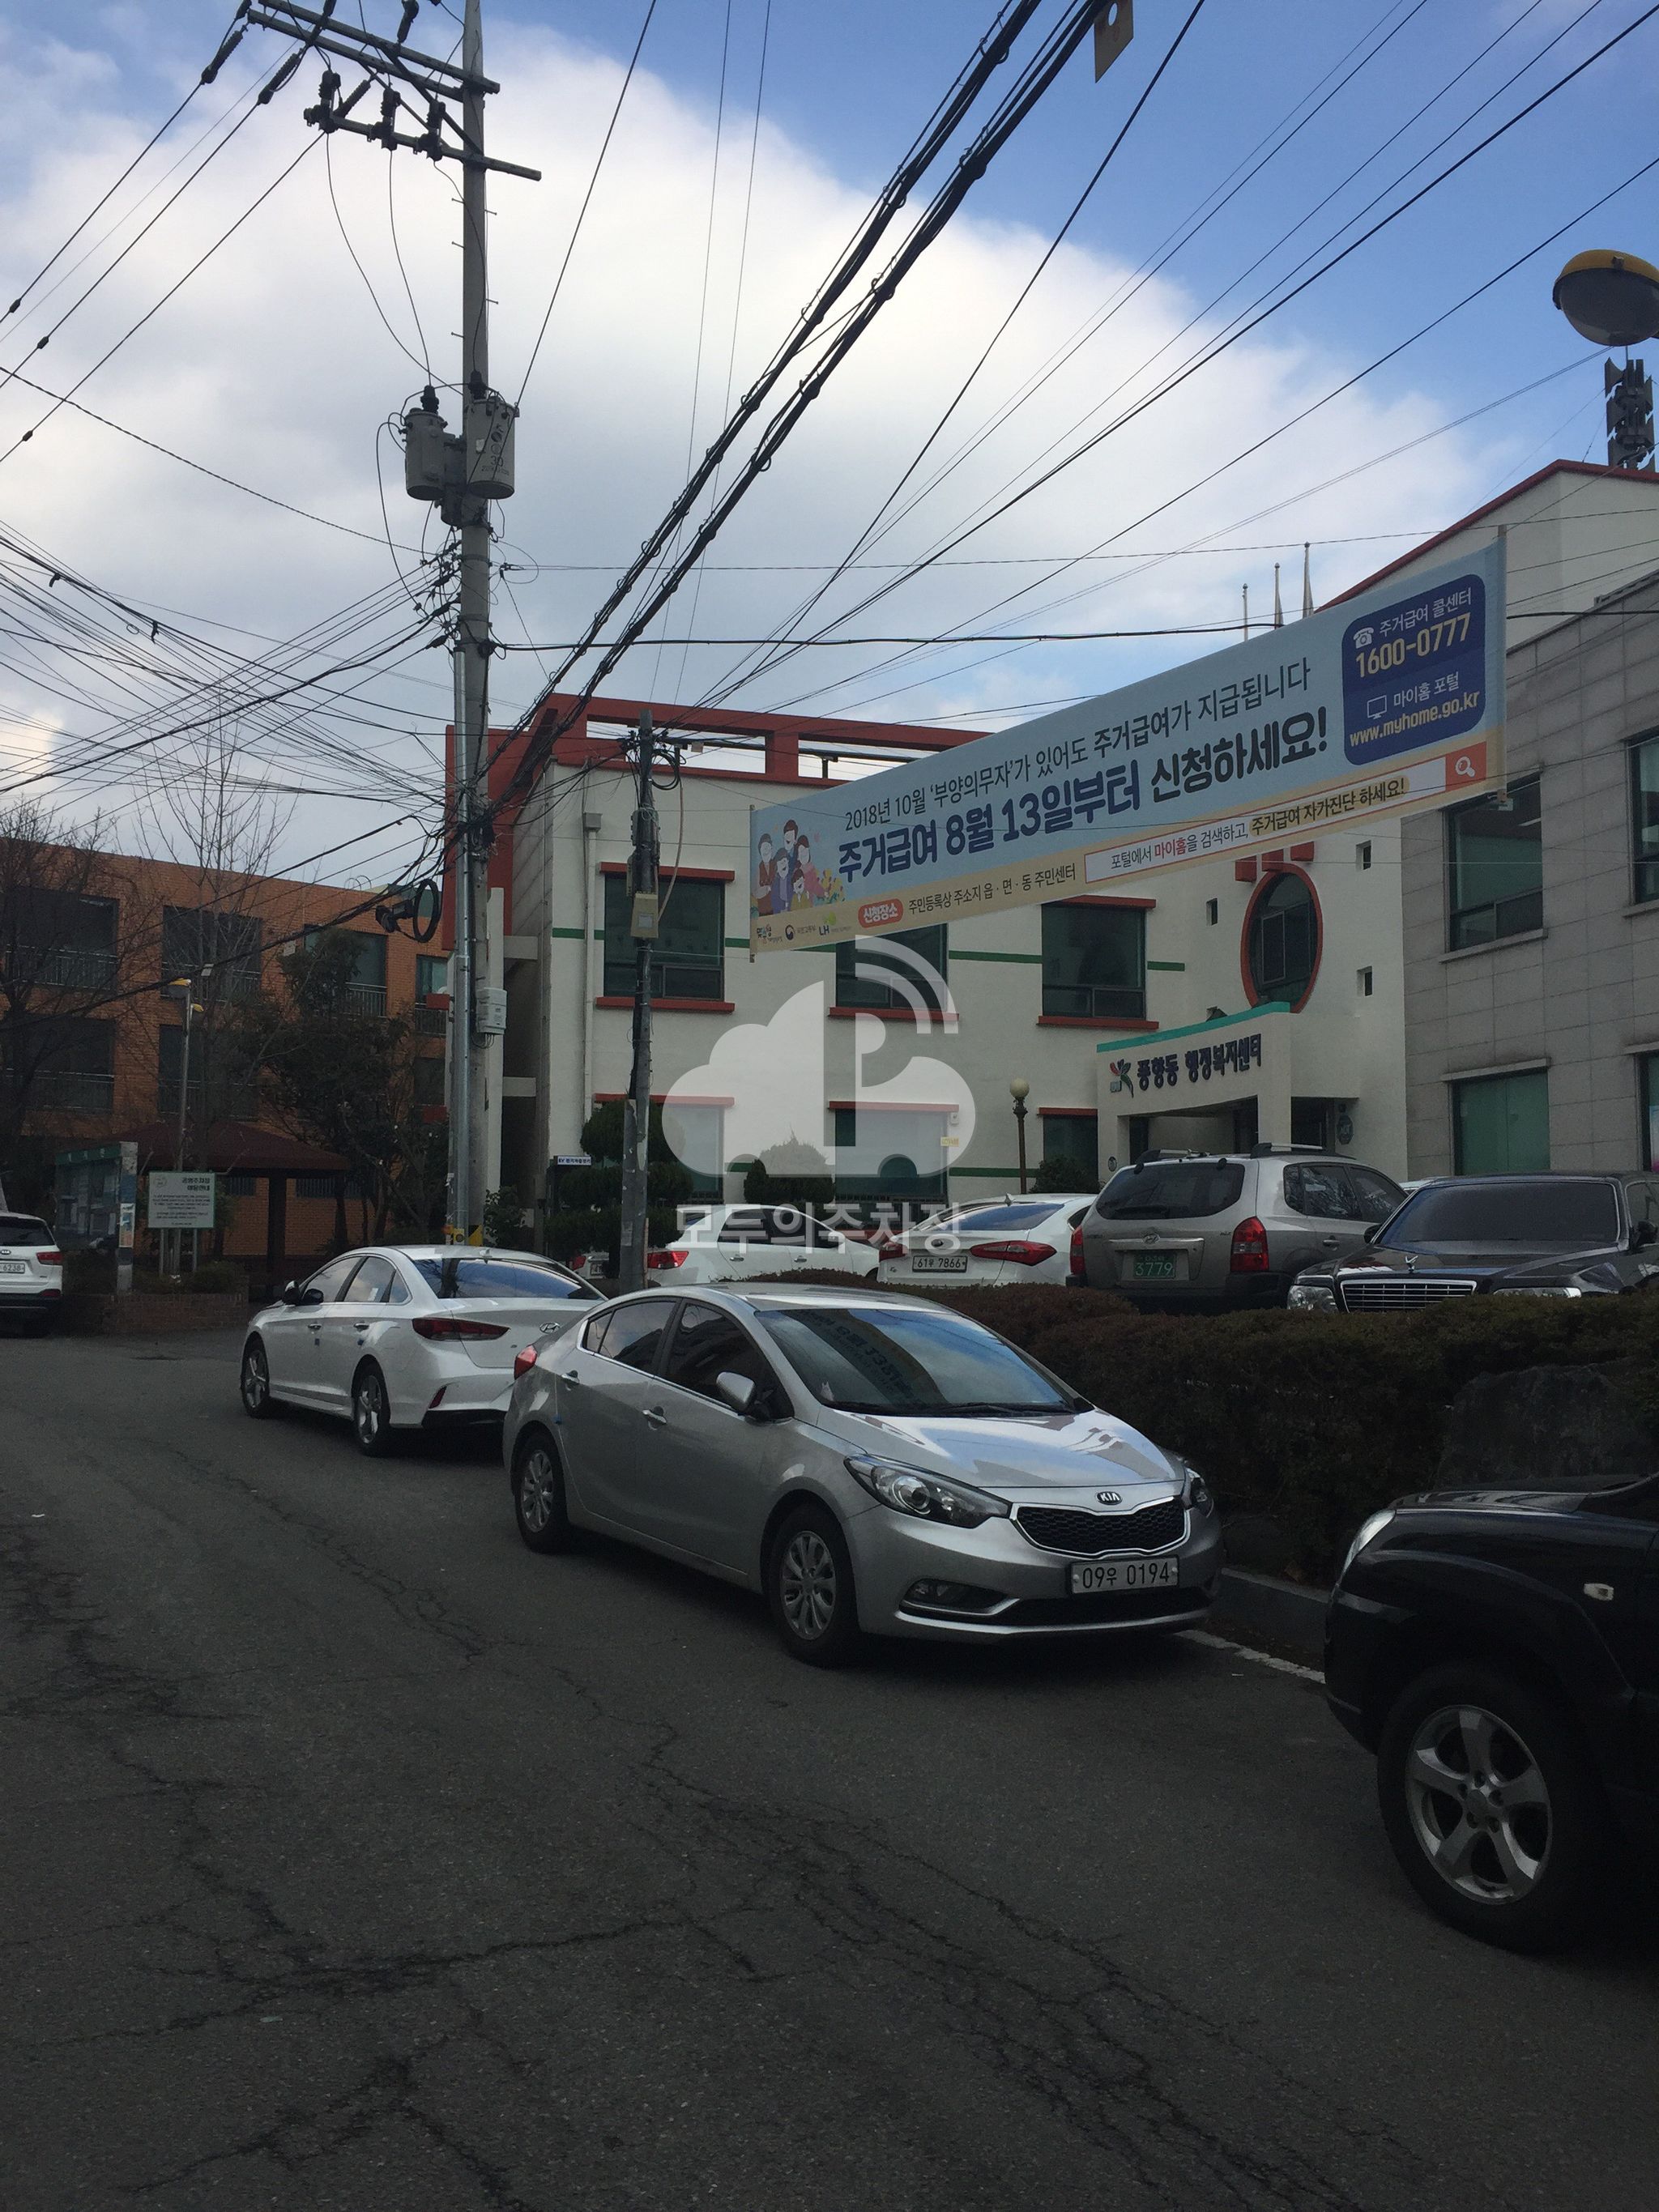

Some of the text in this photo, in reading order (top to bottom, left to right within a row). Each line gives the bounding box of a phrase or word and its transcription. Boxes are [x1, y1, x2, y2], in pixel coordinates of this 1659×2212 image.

[1380, 586, 1472, 637] 주거급여 콜센터
[1356, 612, 1471, 678] 1600-0777
[1393, 671, 1460, 708] 마이홈 포털
[845, 797, 891, 832] 2018년
[895, 787, 927, 816] 10월
[1035, 737, 1089, 778] 있어도
[1094, 700, 1192, 758] 주거급여가
[1197, 657, 1311, 722] 지급됩니다
[1350, 691, 1481, 747] www.myhome.go.kr
[838, 705, 1328, 883] 주거급여 8월 13일부터 신청하세요!
[1111, 846, 1152, 870] 포털에서
[1154, 833, 1198, 859] 마이홈을
[1251, 804, 1302, 836] 주거급여
[1303, 792, 1356, 823] 자가진단
[1358, 777, 1406, 807] 하세요!
[909, 891, 952, 914] 주민등록상
[953, 884, 982, 906] 주소지
[1034, 863, 1077, 889] 주민센터
[818, 925, 830, 936] LH
[1137, 1033, 1262, 1092] 풍향동 행정복지센터
[2, 1264, 22, 1272] 6238
[938, 1258, 962, 1269] 7866
[1135, 1262, 1174, 1277] 3779
[1100, 1493, 1120, 1502] KIA
[1082, 1561, 1170, 1589] 09우 0194
